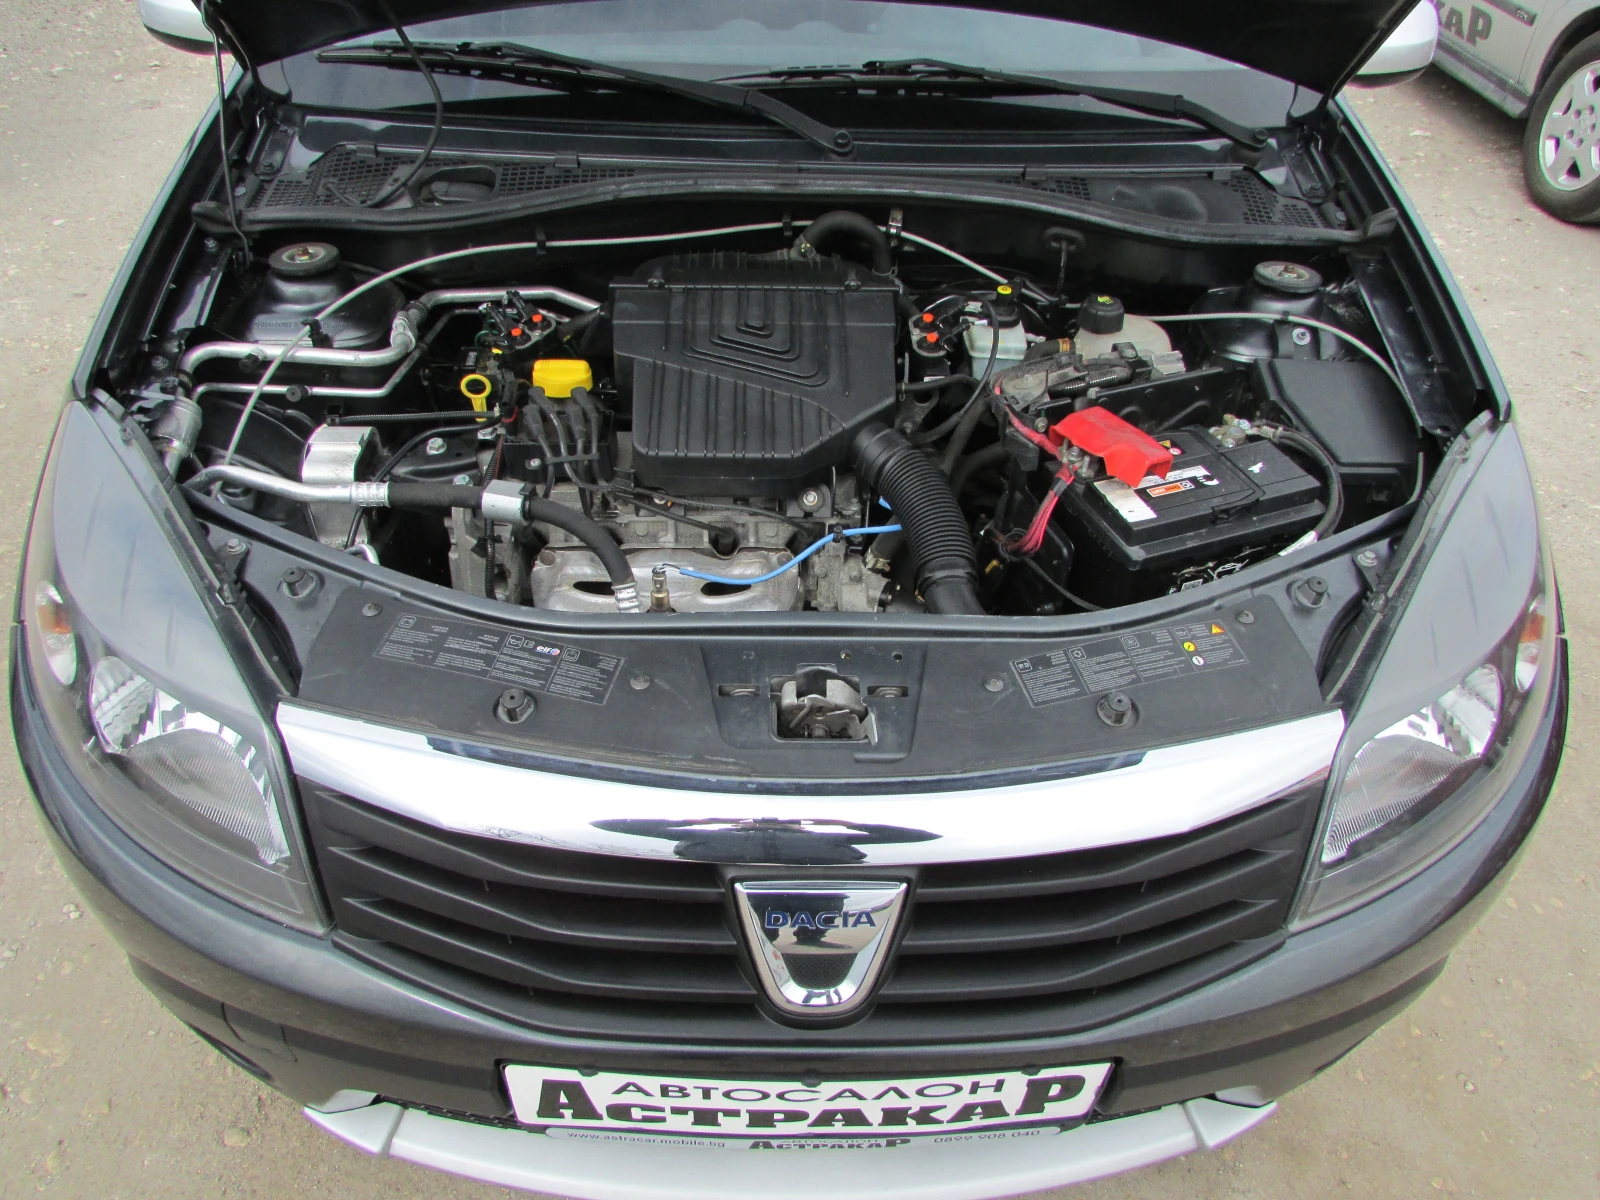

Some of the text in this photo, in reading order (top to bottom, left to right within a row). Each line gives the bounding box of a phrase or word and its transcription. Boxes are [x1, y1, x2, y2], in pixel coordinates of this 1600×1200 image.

[764, 910, 876, 929] DACIA
[611, 1079, 1005, 1102] АВТОСАЛОН
[536, 1075, 1086, 1128] АСТРАКАР
[567, 1131, 725, 1148] www.astracar.mobile.bg
[933, 1135, 973, 1143] 0899
[1011, 1130, 1040, 1138] 040
